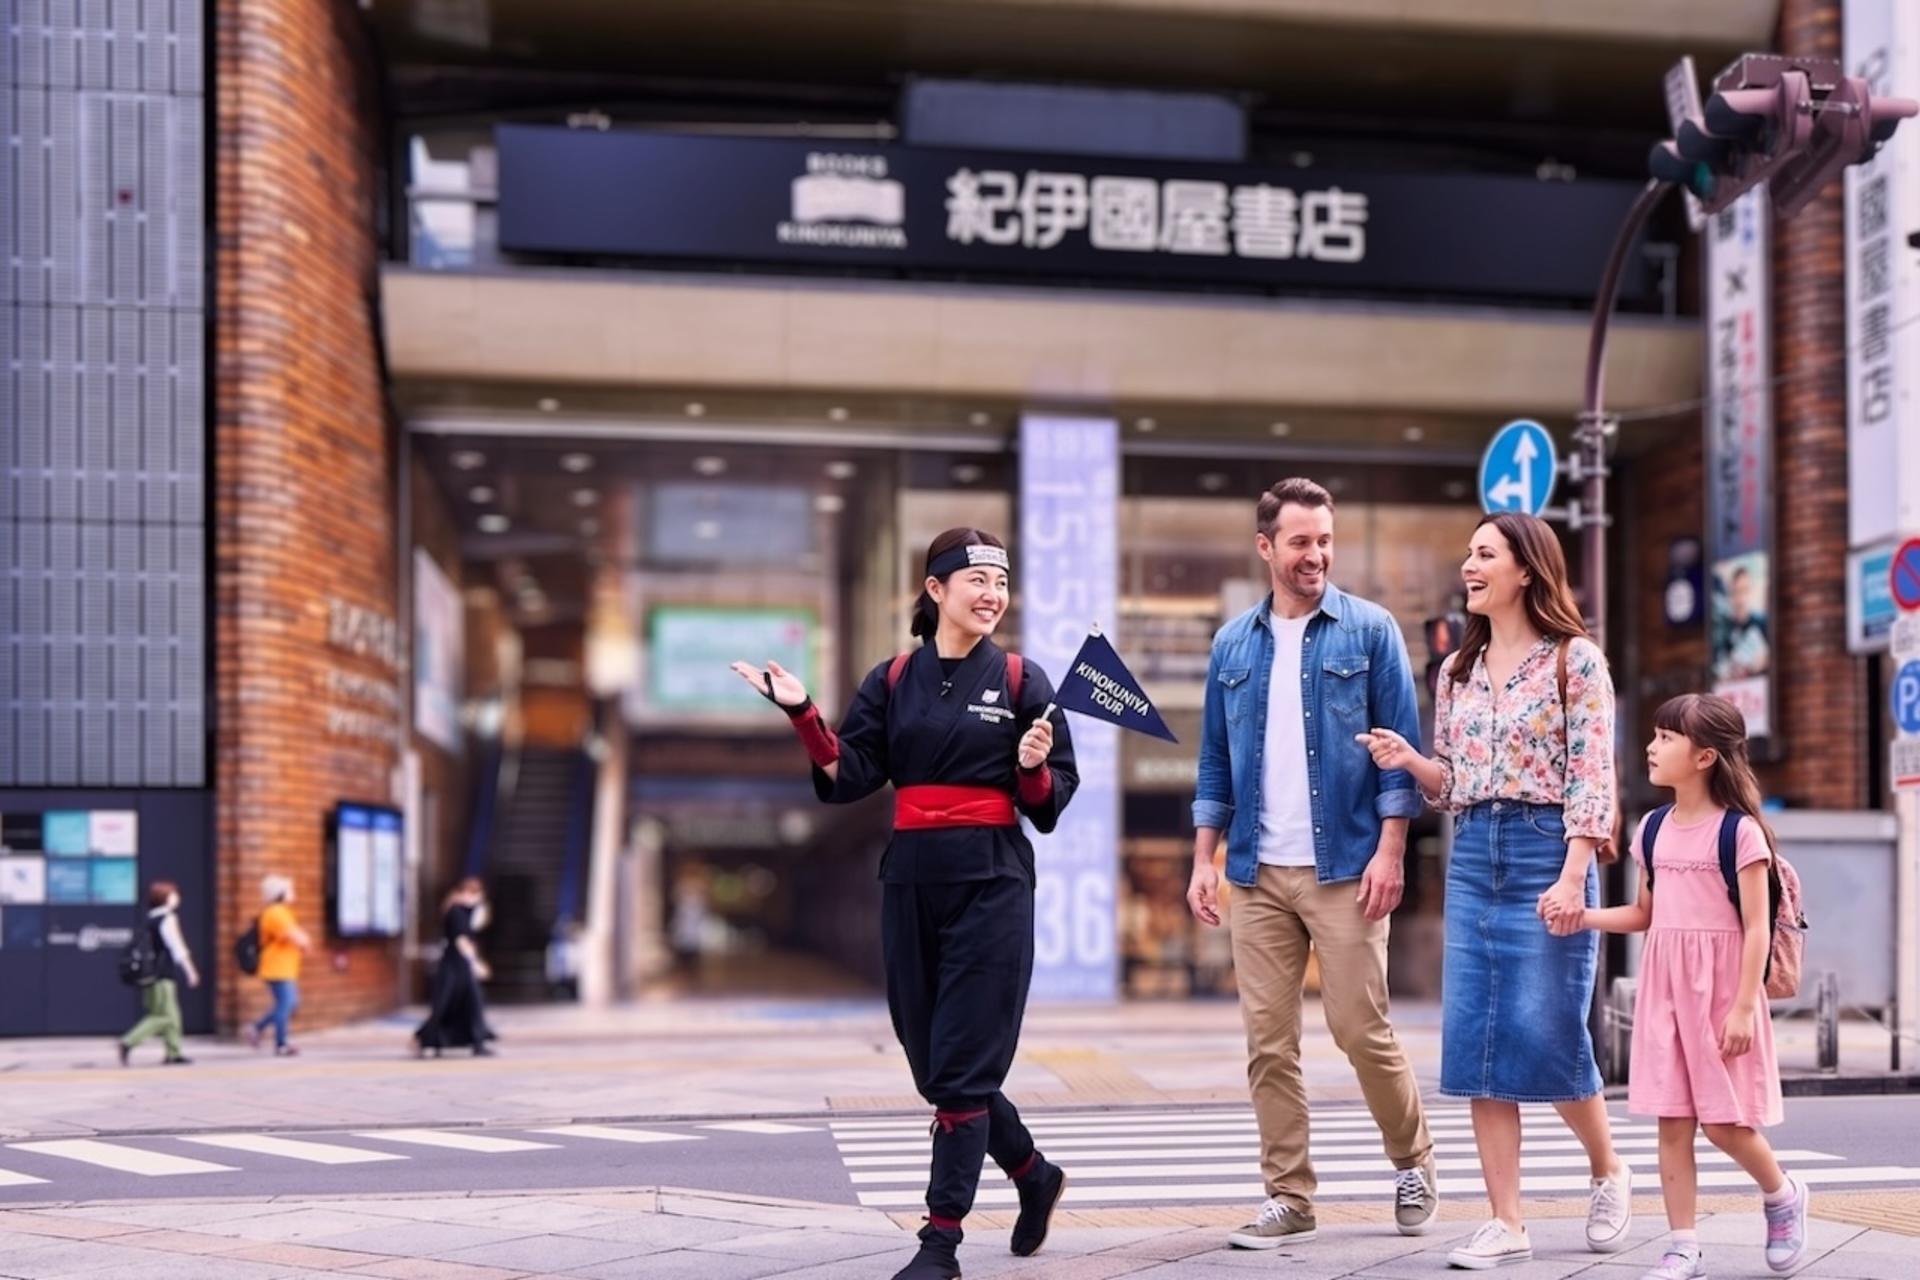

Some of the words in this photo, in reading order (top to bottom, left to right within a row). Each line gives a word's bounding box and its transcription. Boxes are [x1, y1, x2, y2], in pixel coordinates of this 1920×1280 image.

[806, 152, 888, 178] BOOKS
[945, 168, 1369, 262] 紀伊國屋書店
[777, 221, 907, 249] KINOKUNIYA
[1075, 661, 1150, 717] KINOKUNIYA
[1090, 686, 1125, 716] TOUR
